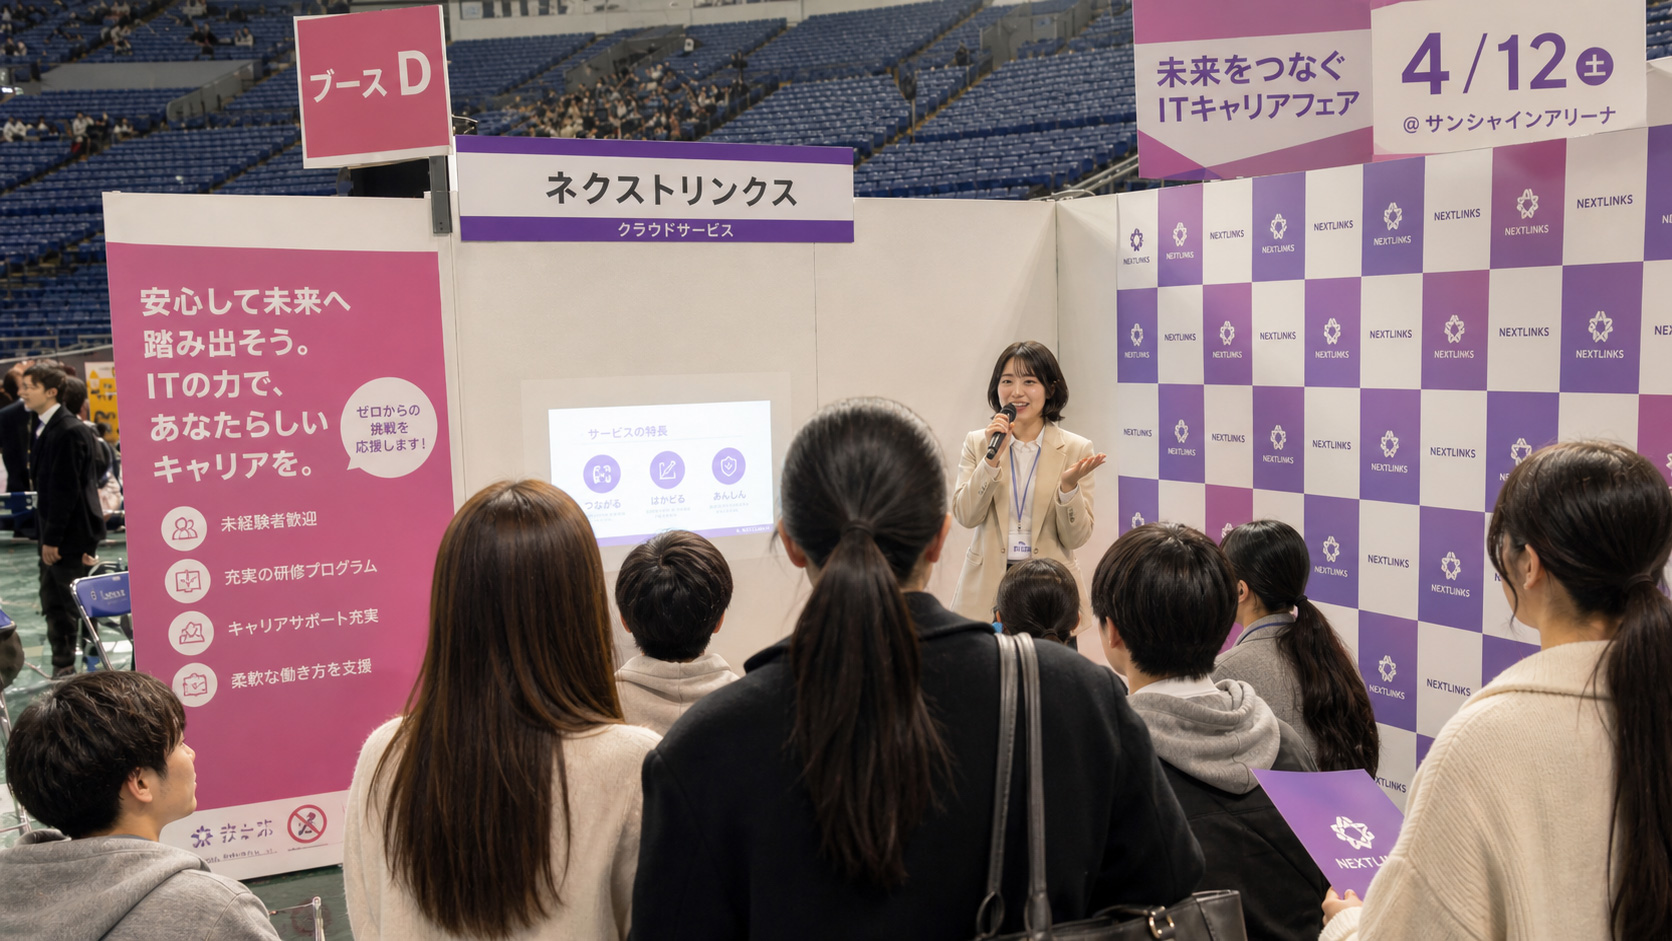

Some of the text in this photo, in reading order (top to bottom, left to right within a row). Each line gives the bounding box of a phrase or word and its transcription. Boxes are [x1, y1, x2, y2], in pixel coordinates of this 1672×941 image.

[1157, 50, 1346, 88] 未来をつなぐ
[310, 50, 431, 102] ブース D
[1159, 91, 1360, 123] ITキャリアフェア
[1426, 107, 1616, 133] サンシャインアリーナ
[546, 171, 798, 207] ネクストリンクス
[1576, 194, 1634, 209] NEXTLINKS
[1433, 208, 1481, 221] NEXTLINKS
[617, 222, 734, 238] クラウドサービス
[1313, 219, 1354, 232] NEXTLINKS
[1504, 224, 1550, 236] NEXTLINKS
[1209, 229, 1245, 240] NEXTLINKS
[1373, 235, 1412, 246] NEXTLINKS
[1165, 250, 1195, 260] NEXTLINKS
[1261, 243, 1295, 254] NEXTLINKS
[1122, 255, 1151, 266] NEXTLINKS
[141, 287, 350, 316] 安心して未来へ
[1164, 332, 1197, 342] NEXTLINKS
[1259, 331, 1297, 341] NEXTLINKS
[1369, 329, 1413, 339] NEXTLINKS
[1499, 326, 1550, 337] NEXTLINKS
[144, 329, 307, 358] 踏み出そう。
[1124, 351, 1151, 359] NEXTLINKS
[1212, 350, 1243, 359] NEXTLINKS
[1314, 350, 1350, 359] NEXTLINKS
[1433, 349, 1475, 359] NEXTLINKS
[1575, 349, 1625, 359] NEXTLINKS
[147, 370, 282, 399] ITの力で、
[356, 404, 421, 419] ゼロからの
[151, 411, 328, 441] あなたらしい
[371, 422, 408, 436] 挑戦を
[588, 425, 667, 440] サービスの特長
[1123, 428, 1153, 438] NEXTLINKS
[1211, 433, 1246, 444] NEXTLINKS
[1312, 439, 1352, 451] NEXTLINKS
[1167, 447, 1197, 457] NEXTLINKS
[1430, 446, 1477, 459] NEXTLINKS
[1262, 454, 1295, 465] NEXTLINKS
[154, 450, 311, 483] キャリアを。
[1370, 462, 1409, 474] NEXTLINKS
[650, 494, 686, 506] はかどる
[712, 489, 747, 501] あんしん
[583, 499, 622, 510] つながる
[221, 511, 317, 532] 未経験者歓迎
[1367, 554, 1410, 569] NEXTLINKS
[225, 560, 377, 585] 充実の研修プログラム
[1313, 565, 1349, 579] NEXTLINKS
[1431, 583, 1471, 598] NEXTLINKS
[229, 608, 378, 636] キャリアサポート充実
[232, 658, 371, 688] 柔軟な働き方を支援
[1369, 685, 1405, 700] NEXTLINKS
[1427, 679, 1471, 696] NEXTLINKS
[1375, 777, 1406, 793] XTLINKS
[1334, 855, 1389, 870] NEXTLI
